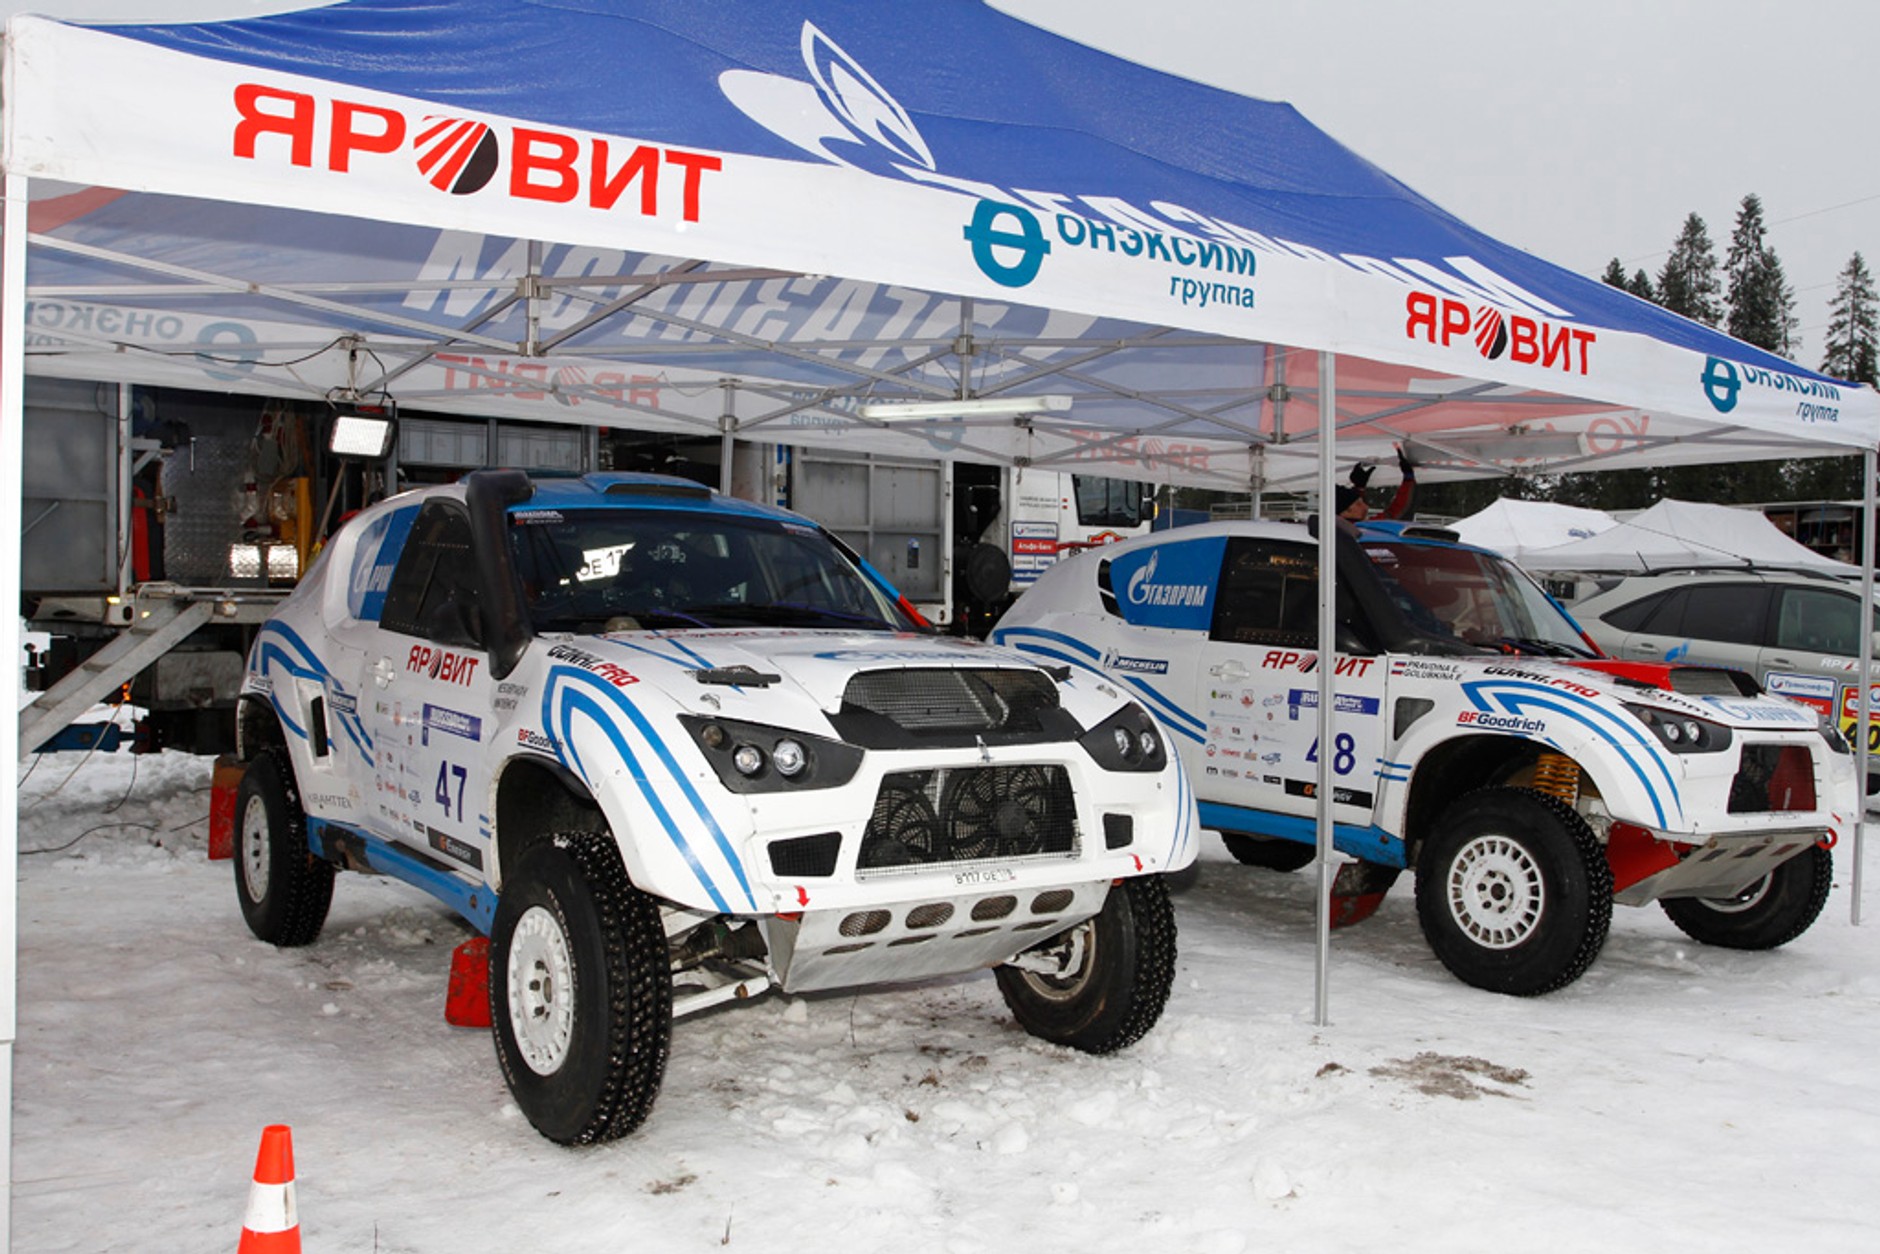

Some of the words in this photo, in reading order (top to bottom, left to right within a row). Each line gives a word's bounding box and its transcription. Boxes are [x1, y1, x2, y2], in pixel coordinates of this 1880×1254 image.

[233, 83, 722, 223] ЯРОВИТ
[1056, 212, 1257, 277] ОНЭКСИМ
[1170, 275, 1255, 309] группа
[1405, 291, 1597, 376] ЯРОВИТ
[1796, 401, 1839, 422] группа
[1262, 650, 1374, 677] ЯРОИТ
[1457, 711, 1545, 733] BFGoodrich
[435, 760, 467, 823] 47
